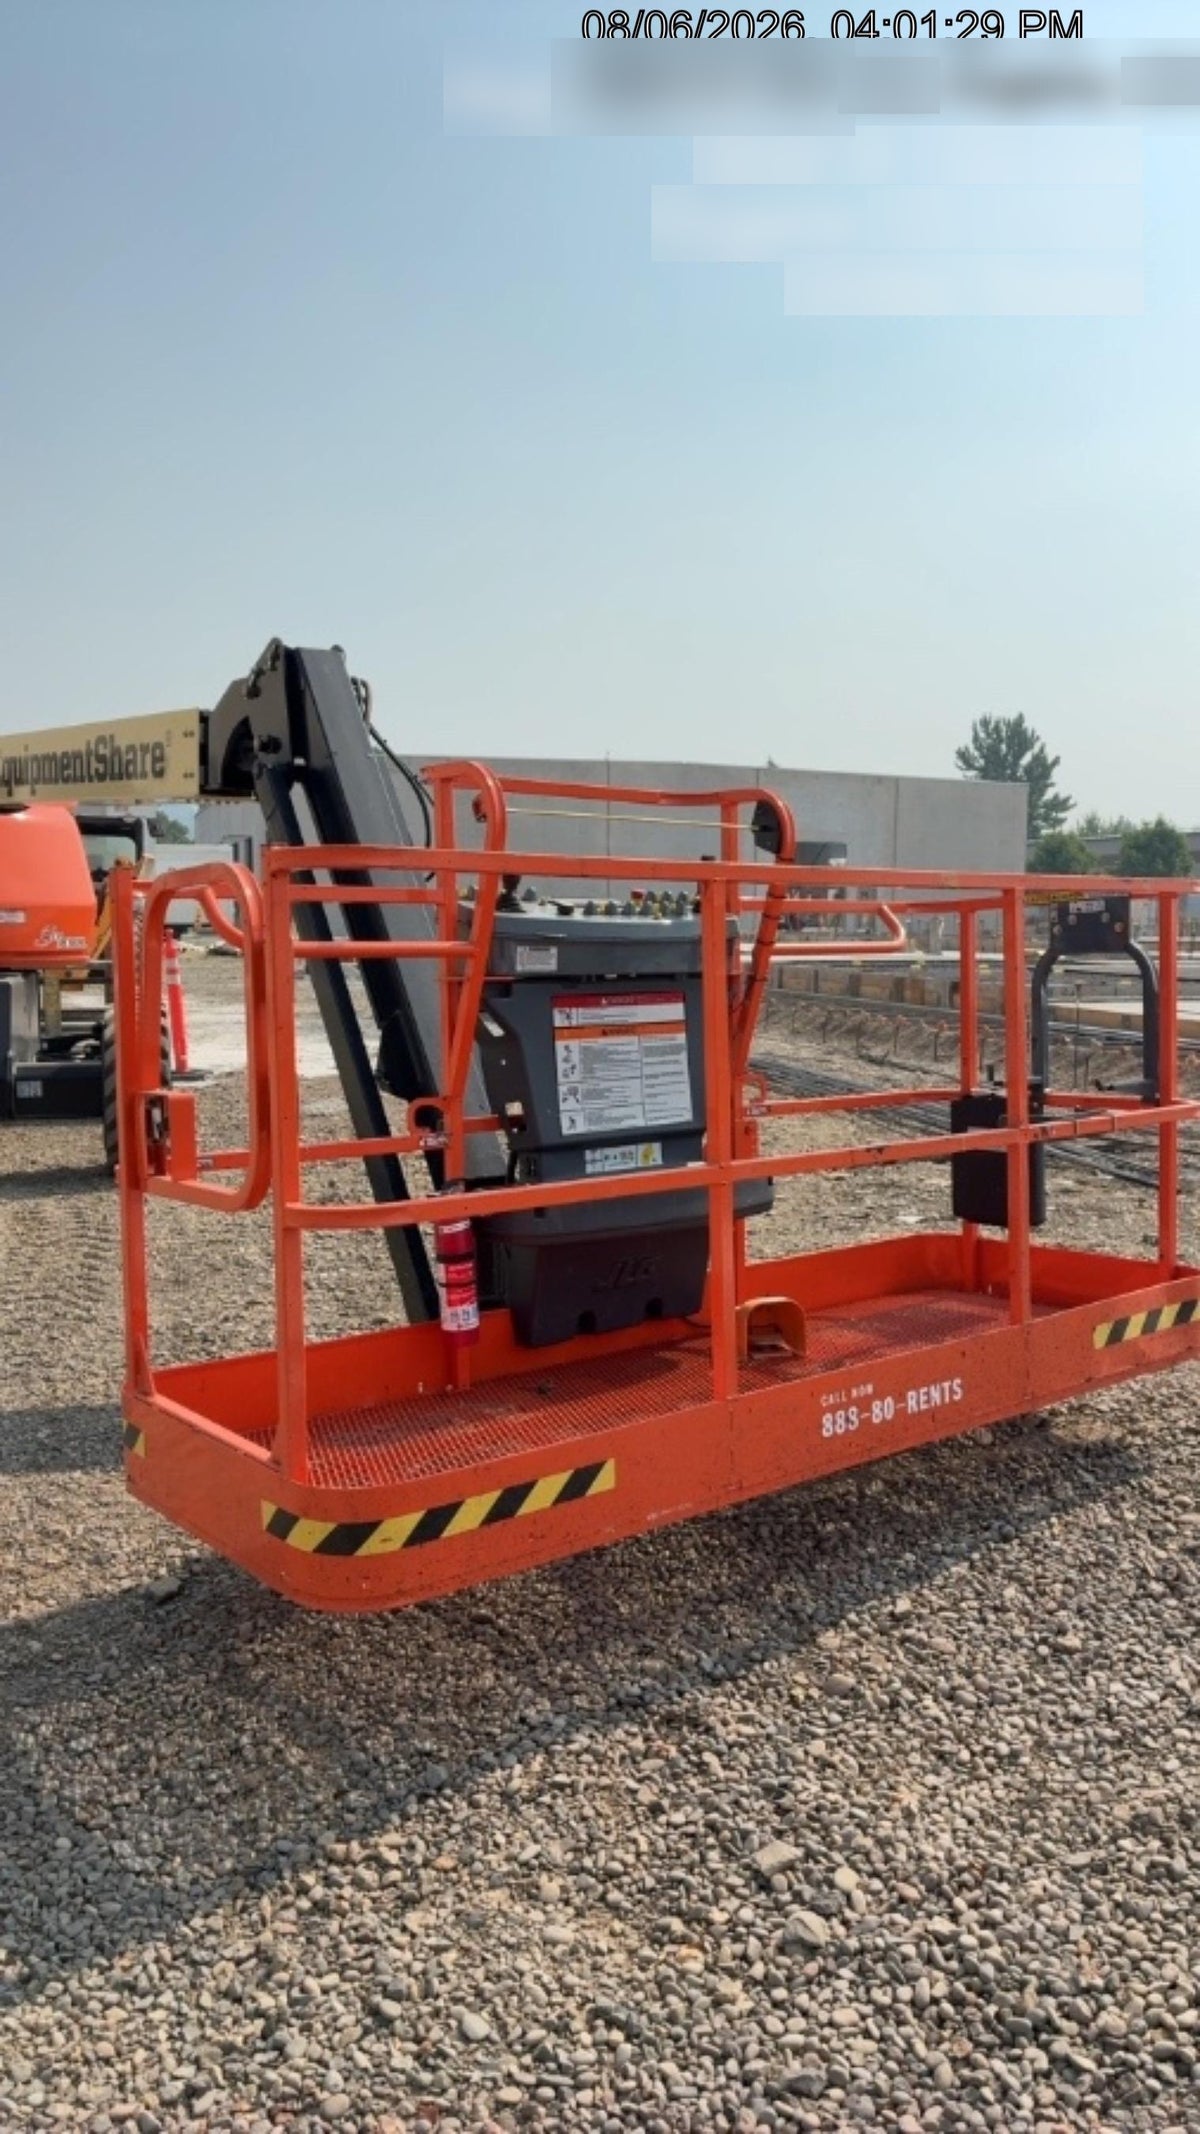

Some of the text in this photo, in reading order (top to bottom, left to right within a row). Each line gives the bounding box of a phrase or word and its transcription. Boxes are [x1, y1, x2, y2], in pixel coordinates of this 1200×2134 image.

[0, 733, 166, 797] quipmentShare
[820, 1383, 874, 1407] CALL NOW
[821, 1377, 963, 1438] 888-80-RENTS
